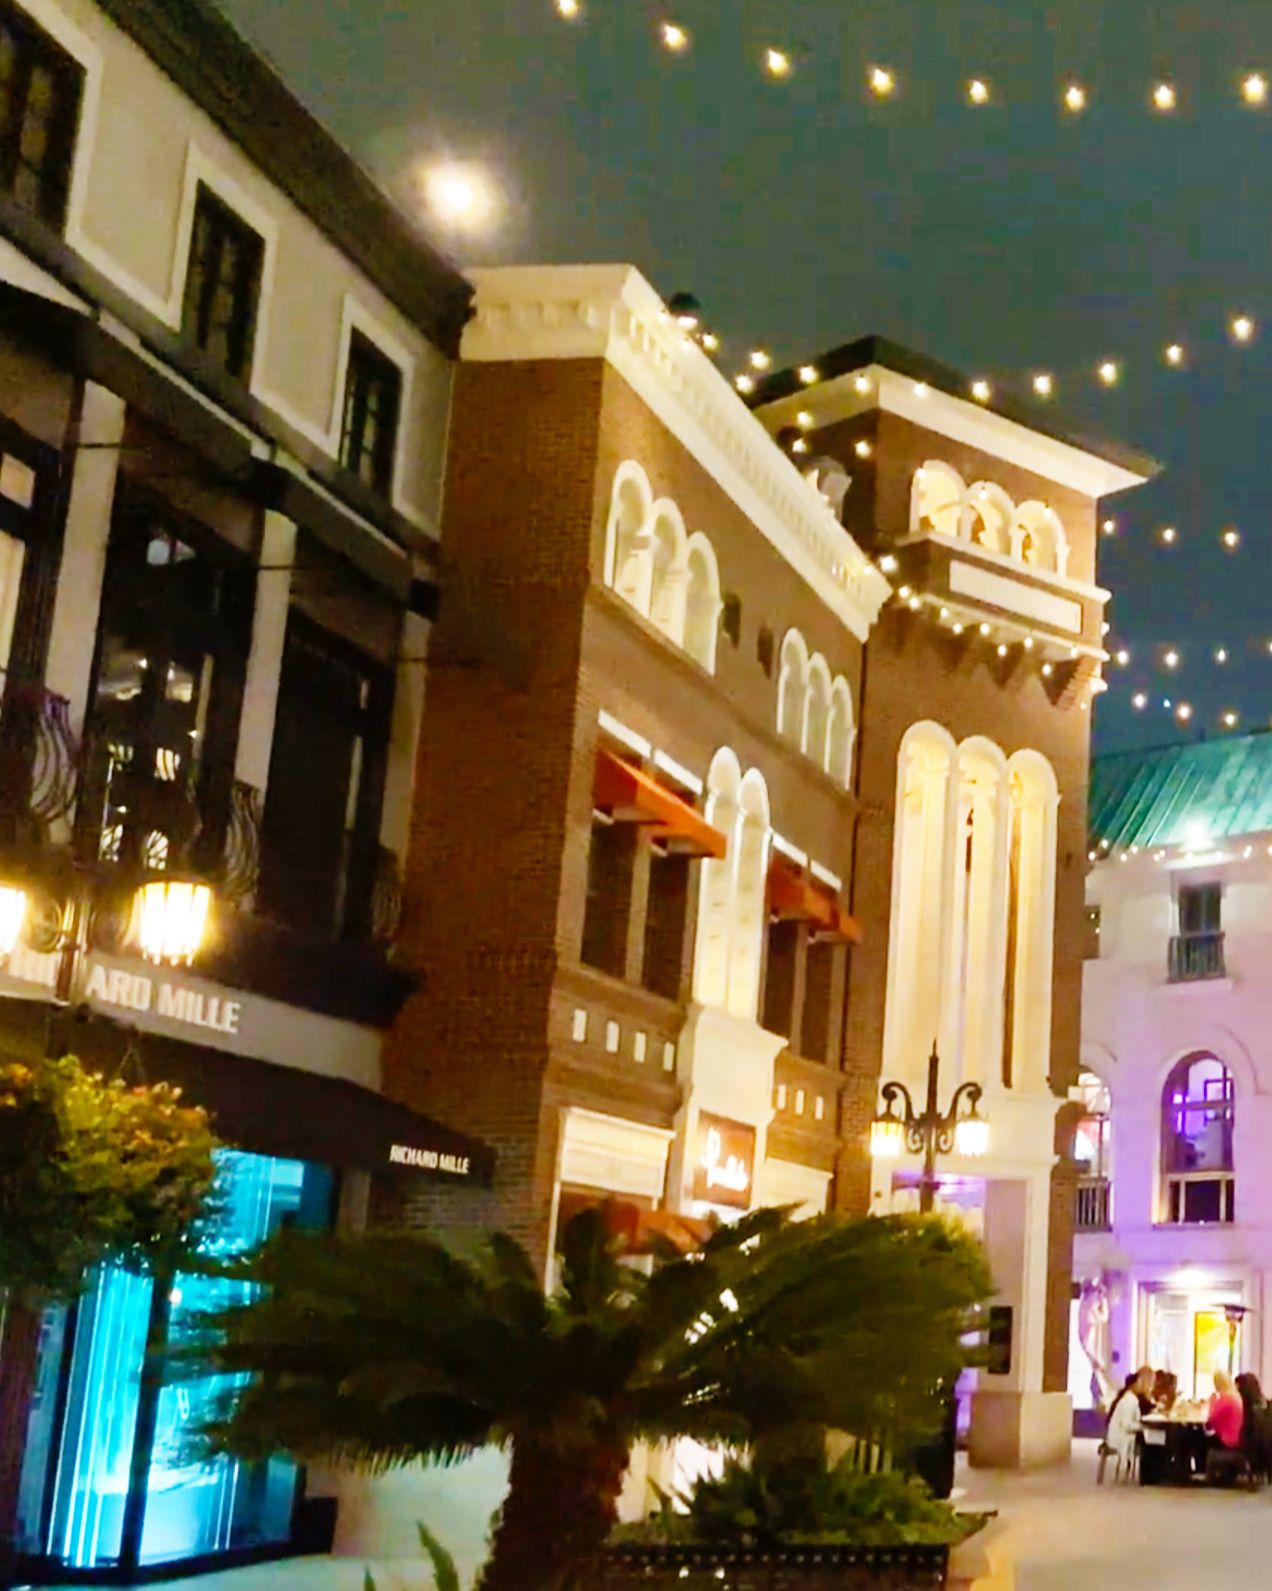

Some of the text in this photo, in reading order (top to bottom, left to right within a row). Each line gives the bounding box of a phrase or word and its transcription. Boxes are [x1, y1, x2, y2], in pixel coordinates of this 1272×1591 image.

[157, 984, 240, 1034] MILLE
[389, 1144, 469, 1174] RICHARD MILLE
